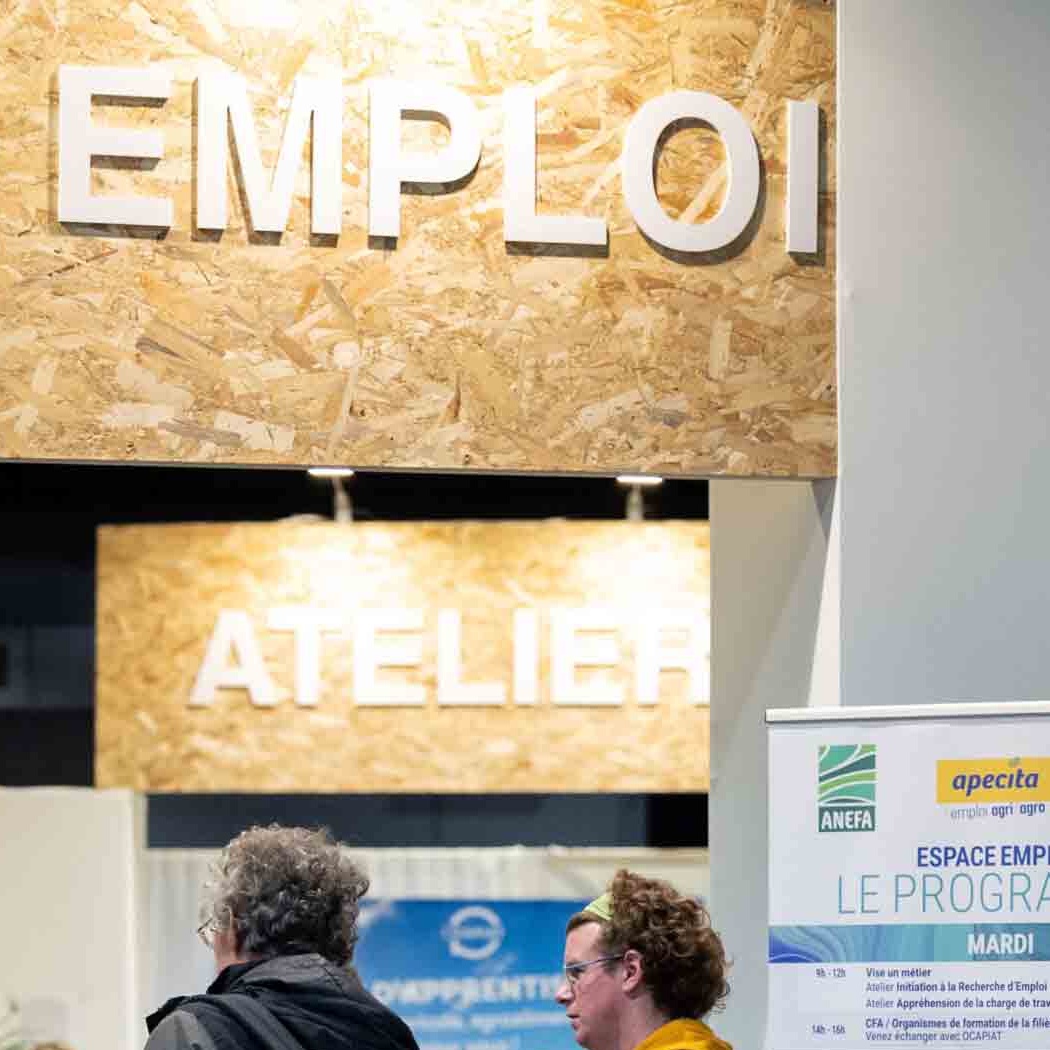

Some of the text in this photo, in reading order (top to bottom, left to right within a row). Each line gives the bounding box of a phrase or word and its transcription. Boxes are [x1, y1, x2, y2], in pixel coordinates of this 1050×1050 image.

[54, 64, 823, 264] EMPLOI
[186, 606, 710, 708] ATELIER
[952, 769, 1039, 796] apecita
[821, 810, 873, 830] ANEFA
[991, 804, 1013, 817] agri
[1020, 803, 1045, 815] agro
[917, 845, 1050, 867] ESPACE EMP
[838, 875, 879, 914] LE
[967, 933, 1034, 955] MARDI
[866, 968, 932, 978] Vise un métier
[866, 981, 1047, 992] Atelier Initiation Recherche d'Emploi
[866, 998, 1030, 1010] Atelier Appréhension de charge de
[866, 1018, 1006, 1030] CFA Organismes de formation
[866, 1032, 892, 1040] Venez
[894, 1031, 937, 1043] échanger
[962, 1031, 1001, 1040] OCAPIAT
